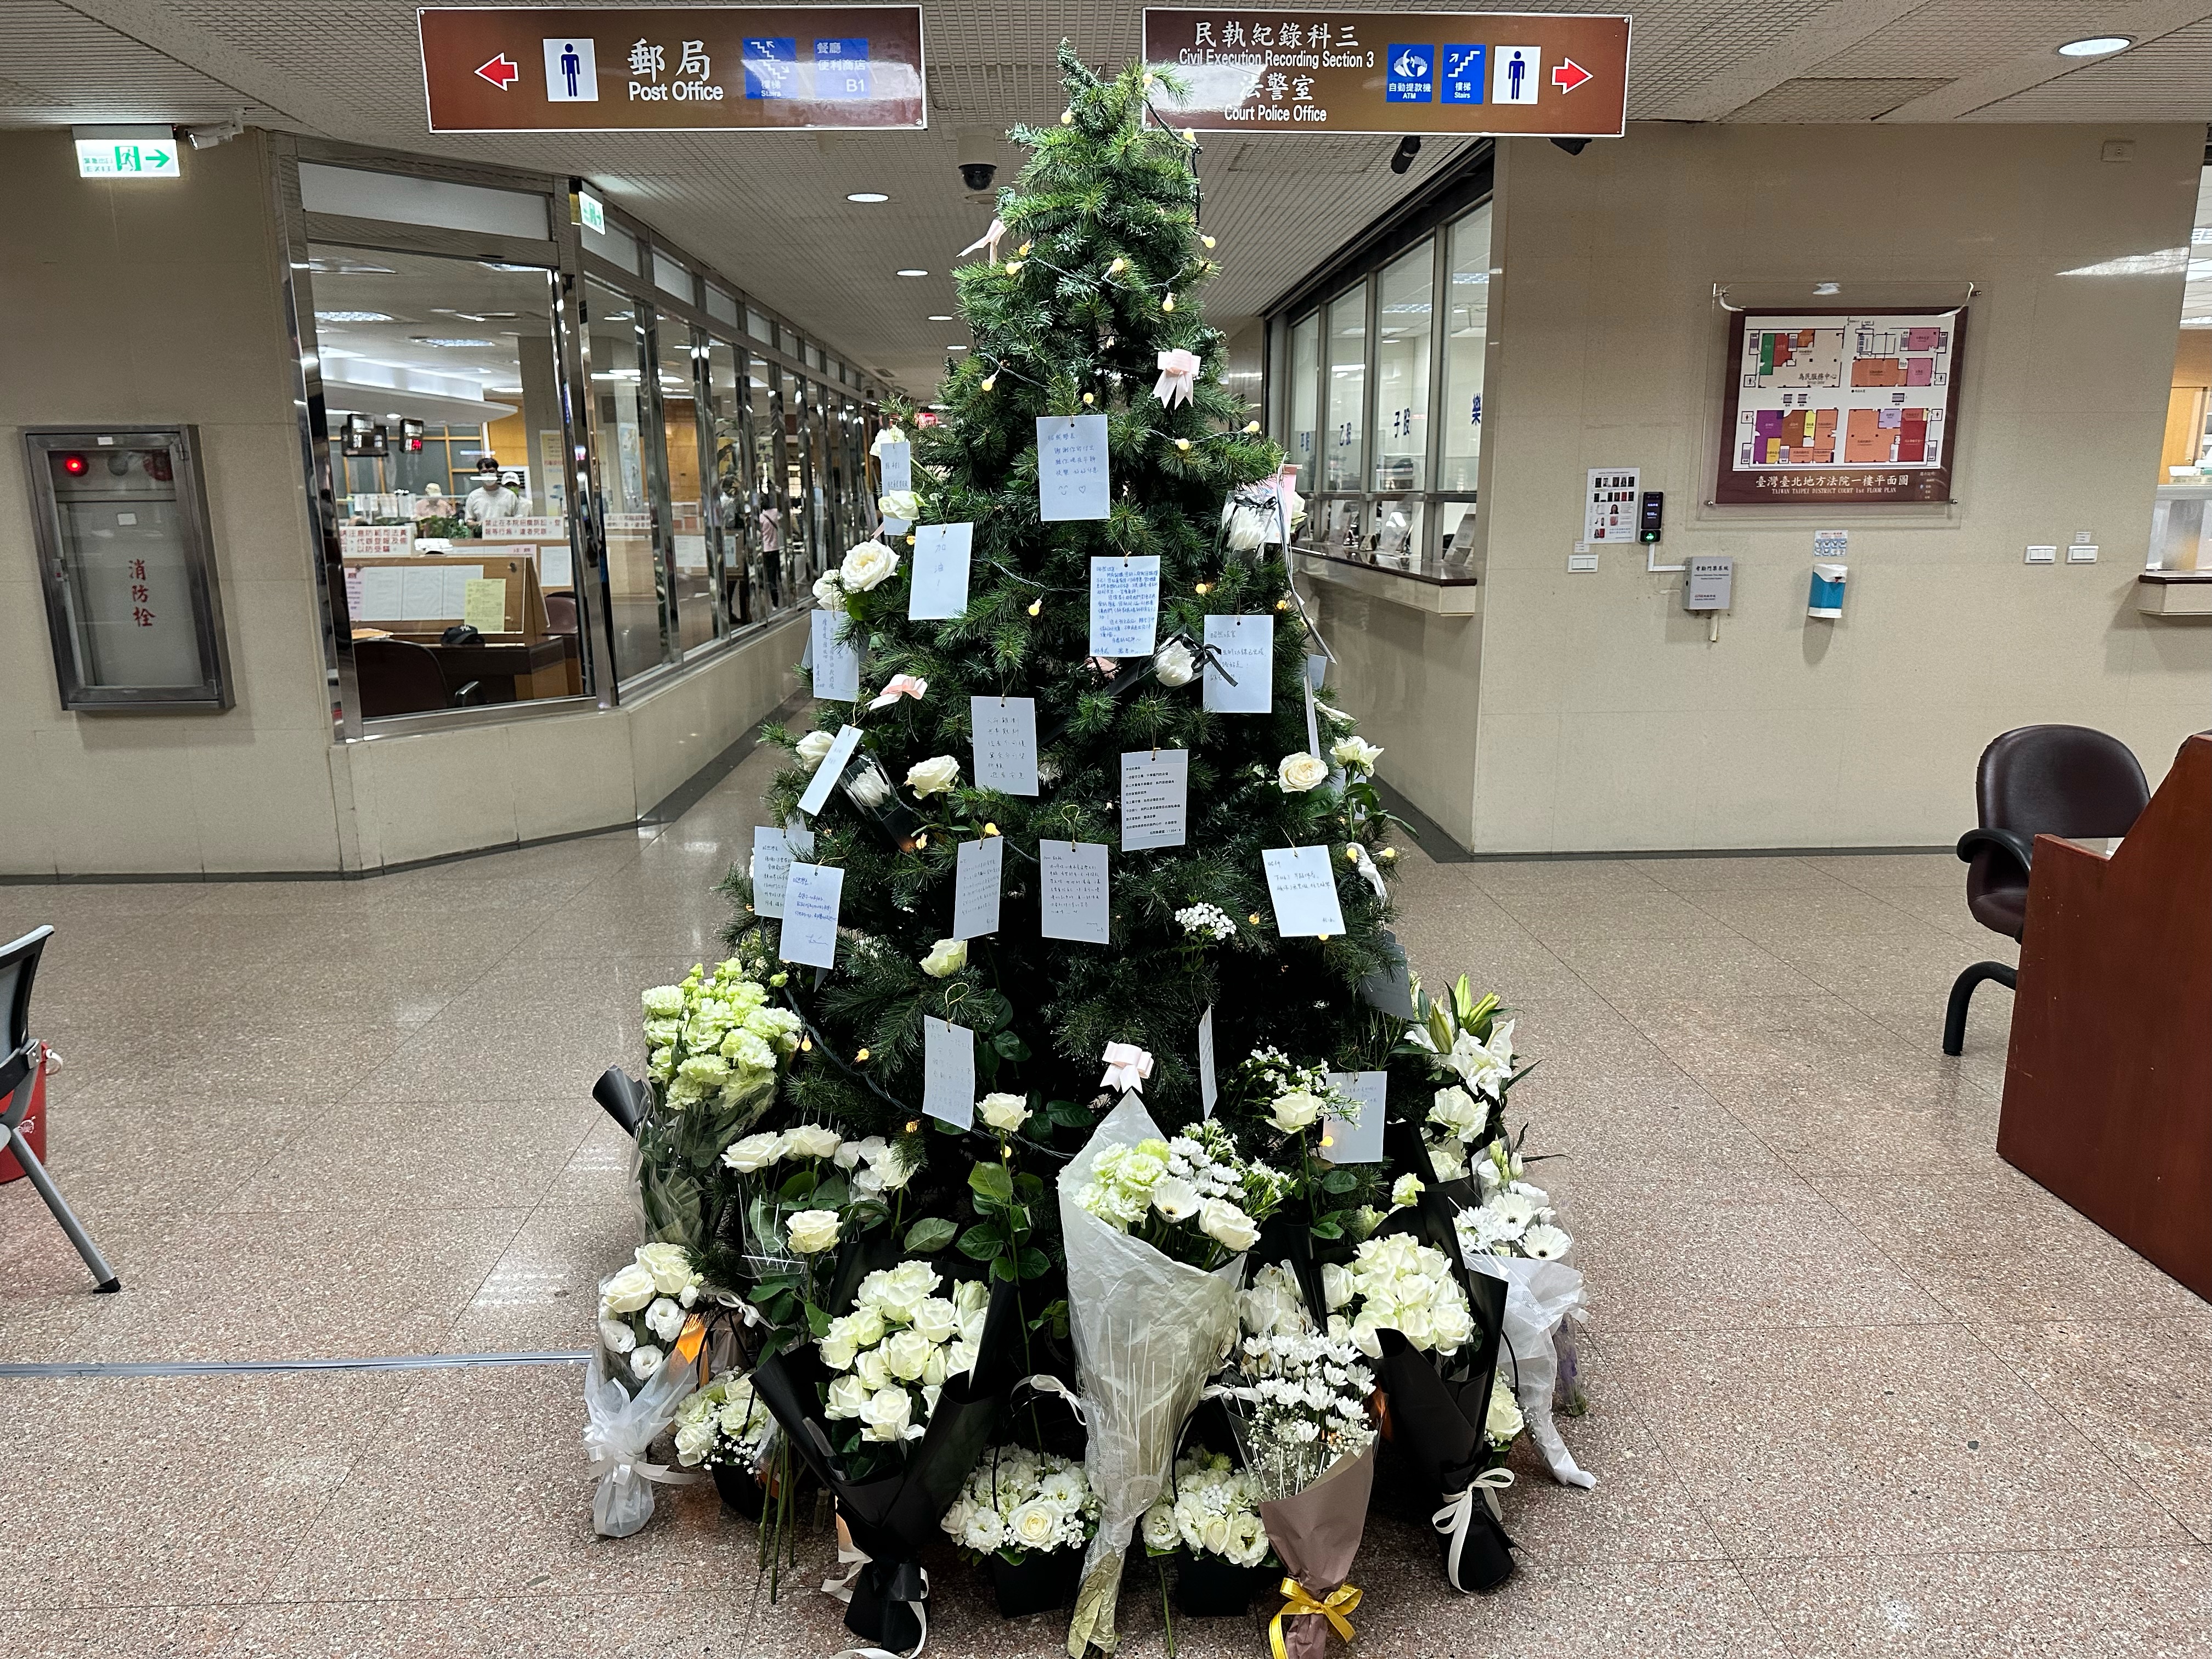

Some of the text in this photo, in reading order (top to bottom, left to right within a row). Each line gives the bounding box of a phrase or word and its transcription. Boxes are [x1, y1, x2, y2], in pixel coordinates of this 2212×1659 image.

[1194, 21, 1359, 49] 民執紀錄科三
[817, 42, 841, 54] 餐廳
[627, 37, 711, 83] 郵局
[817, 59, 866, 71] 便利商店
[1179, 48, 1374, 69] Civil Execution Recording Section 3
[629, 81, 724, 101] Post Office
[846, 79, 865, 92] B1
[1389, 83, 1431, 92] 自動提款機
[1455, 82, 1471, 91] 樓梯
[1224, 104, 1327, 122] Court Police Office
[1756, 474, 1909, 488] 臺灣臺北地方法院一樓平面圖
[128, 558, 155, 627] 消防栓
